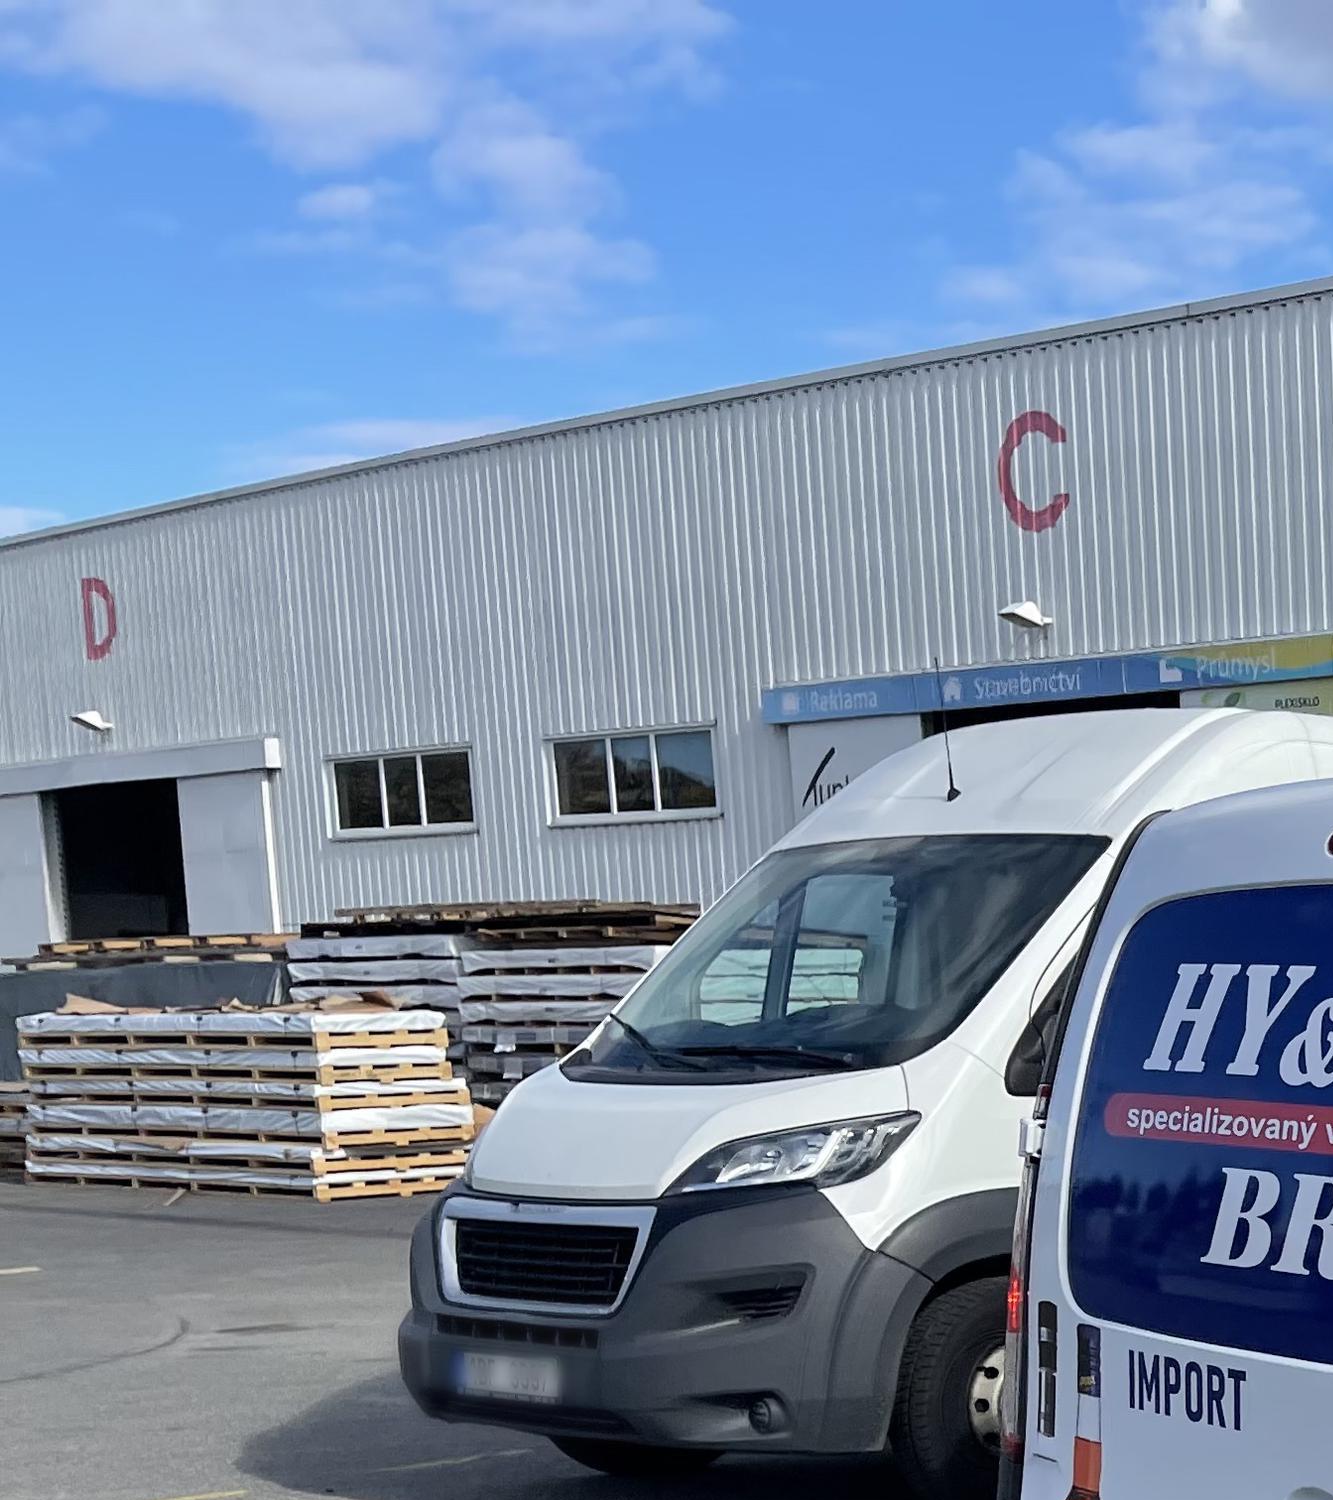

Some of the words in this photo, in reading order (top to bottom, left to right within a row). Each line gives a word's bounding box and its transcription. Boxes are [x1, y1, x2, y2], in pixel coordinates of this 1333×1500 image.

[998, 411, 1070, 532] C
[81, 577, 116, 661] D
[974, 667, 1081, 698] Stavebnictví
[1196, 652, 1276, 680] Průmysl
[807, 689, 878, 712] Reklama
[1275, 696, 1320, 709] PLEXISKLO
[1126, 1104, 1317, 1150] specializovaný
[1128, 1349, 1247, 1431] IMPORT
